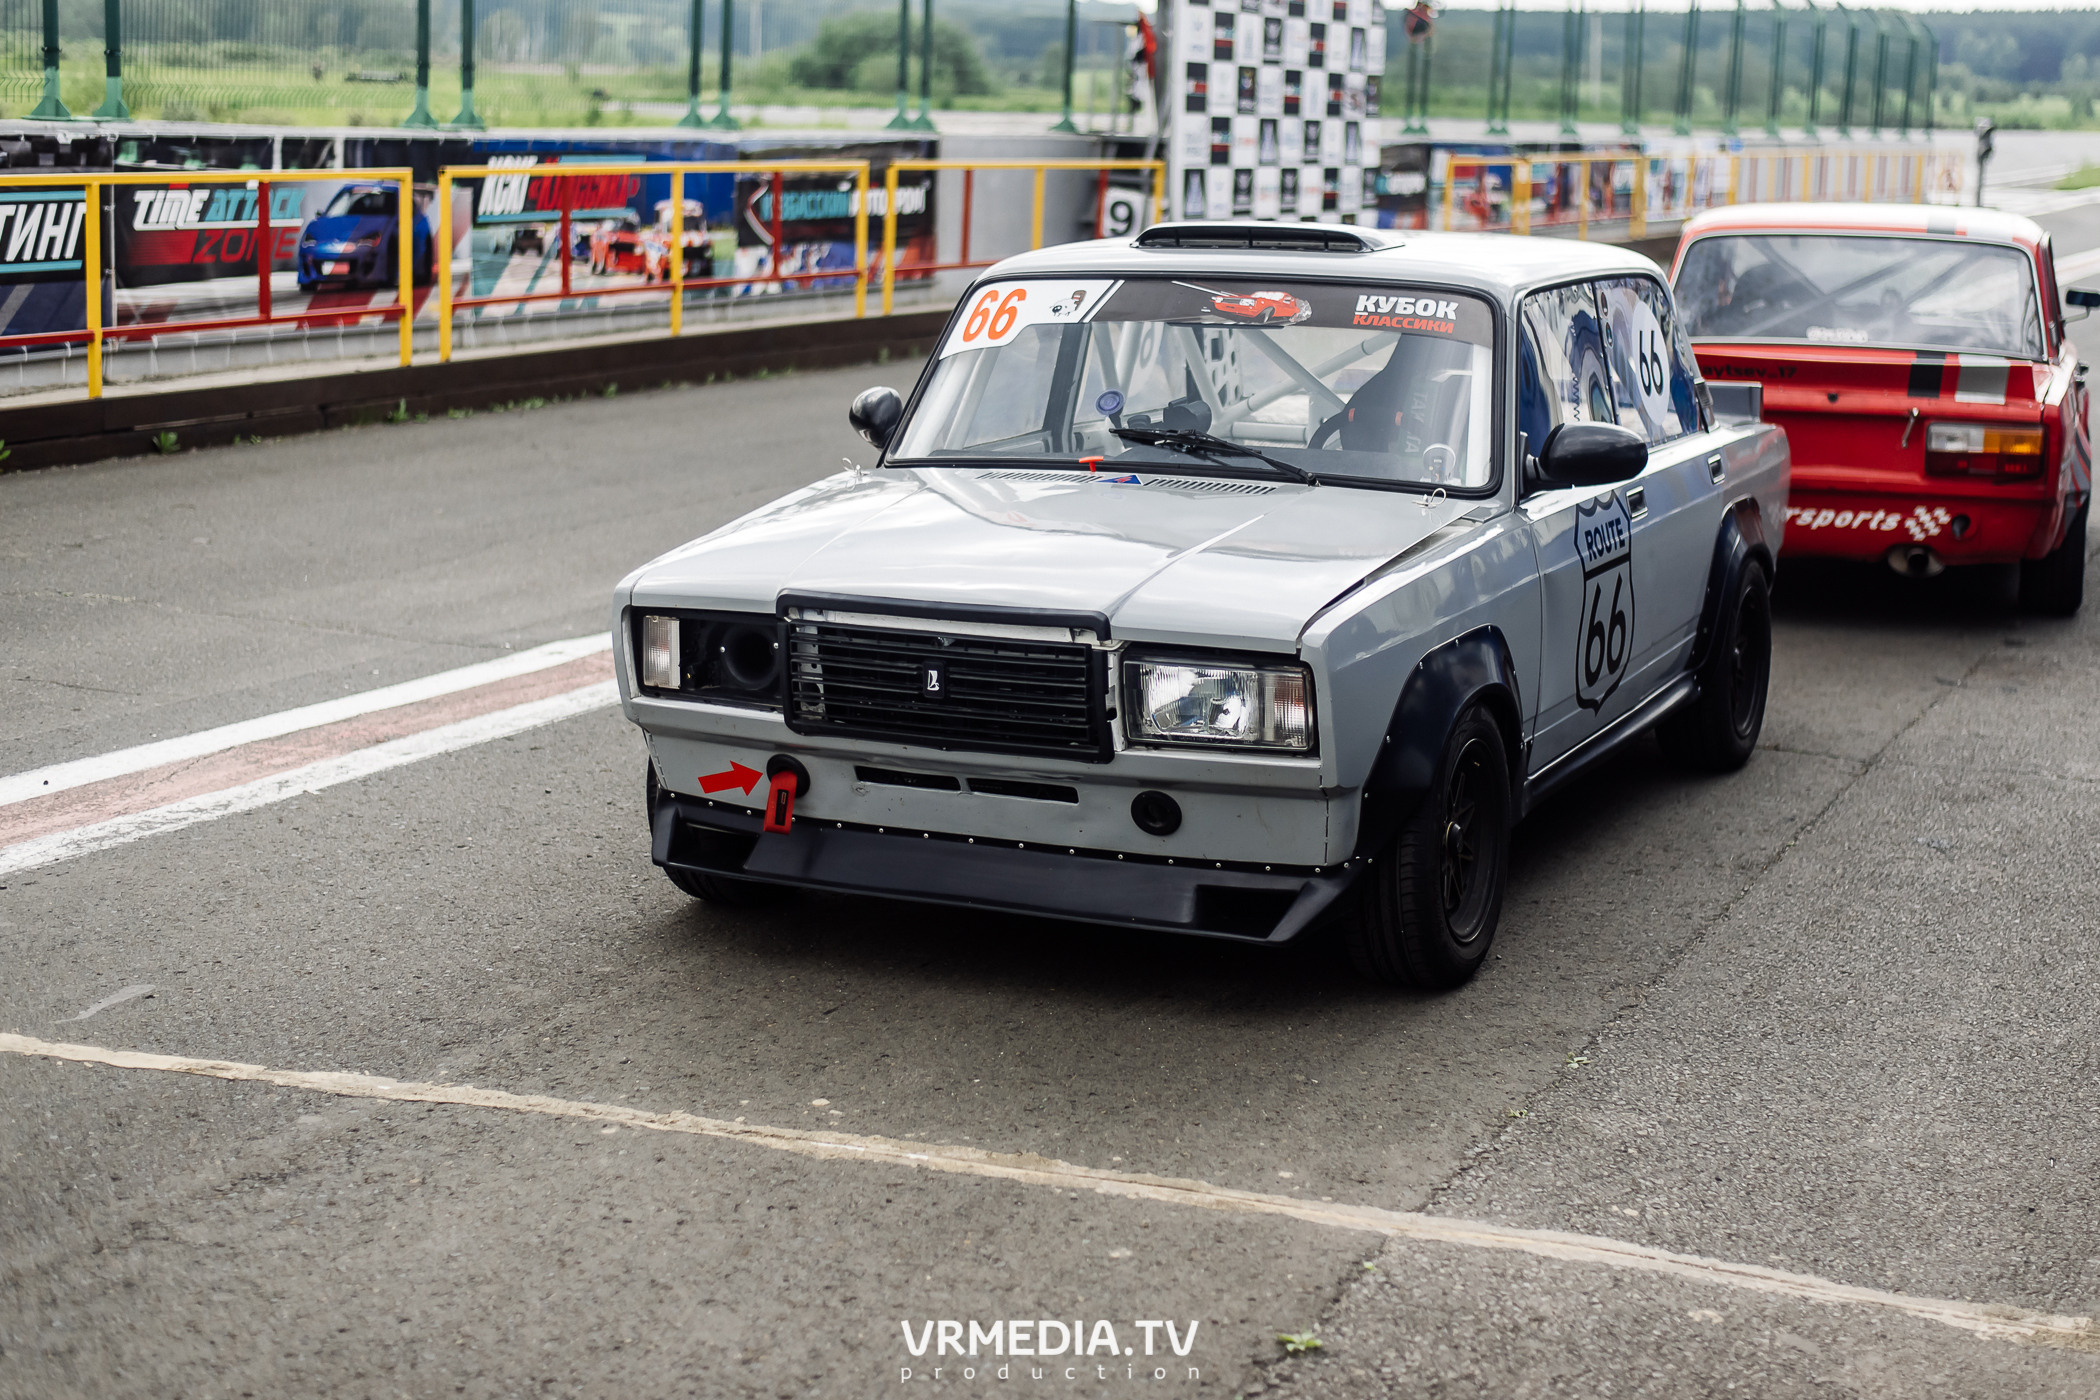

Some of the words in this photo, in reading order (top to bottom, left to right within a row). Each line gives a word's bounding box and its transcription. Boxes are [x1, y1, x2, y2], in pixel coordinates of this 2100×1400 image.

[133, 189, 210, 231] TIME
[1110, 200, 1133, 236] 9
[963, 288, 1027, 342] 66
[1353, 314, 1455, 334] КЛАССИКИ
[1355, 294, 1460, 320] КУБОК
[1639, 330, 1664, 397] 66
[1585, 517, 1626, 562] ROUTE
[1585, 571, 1627, 688] 66
